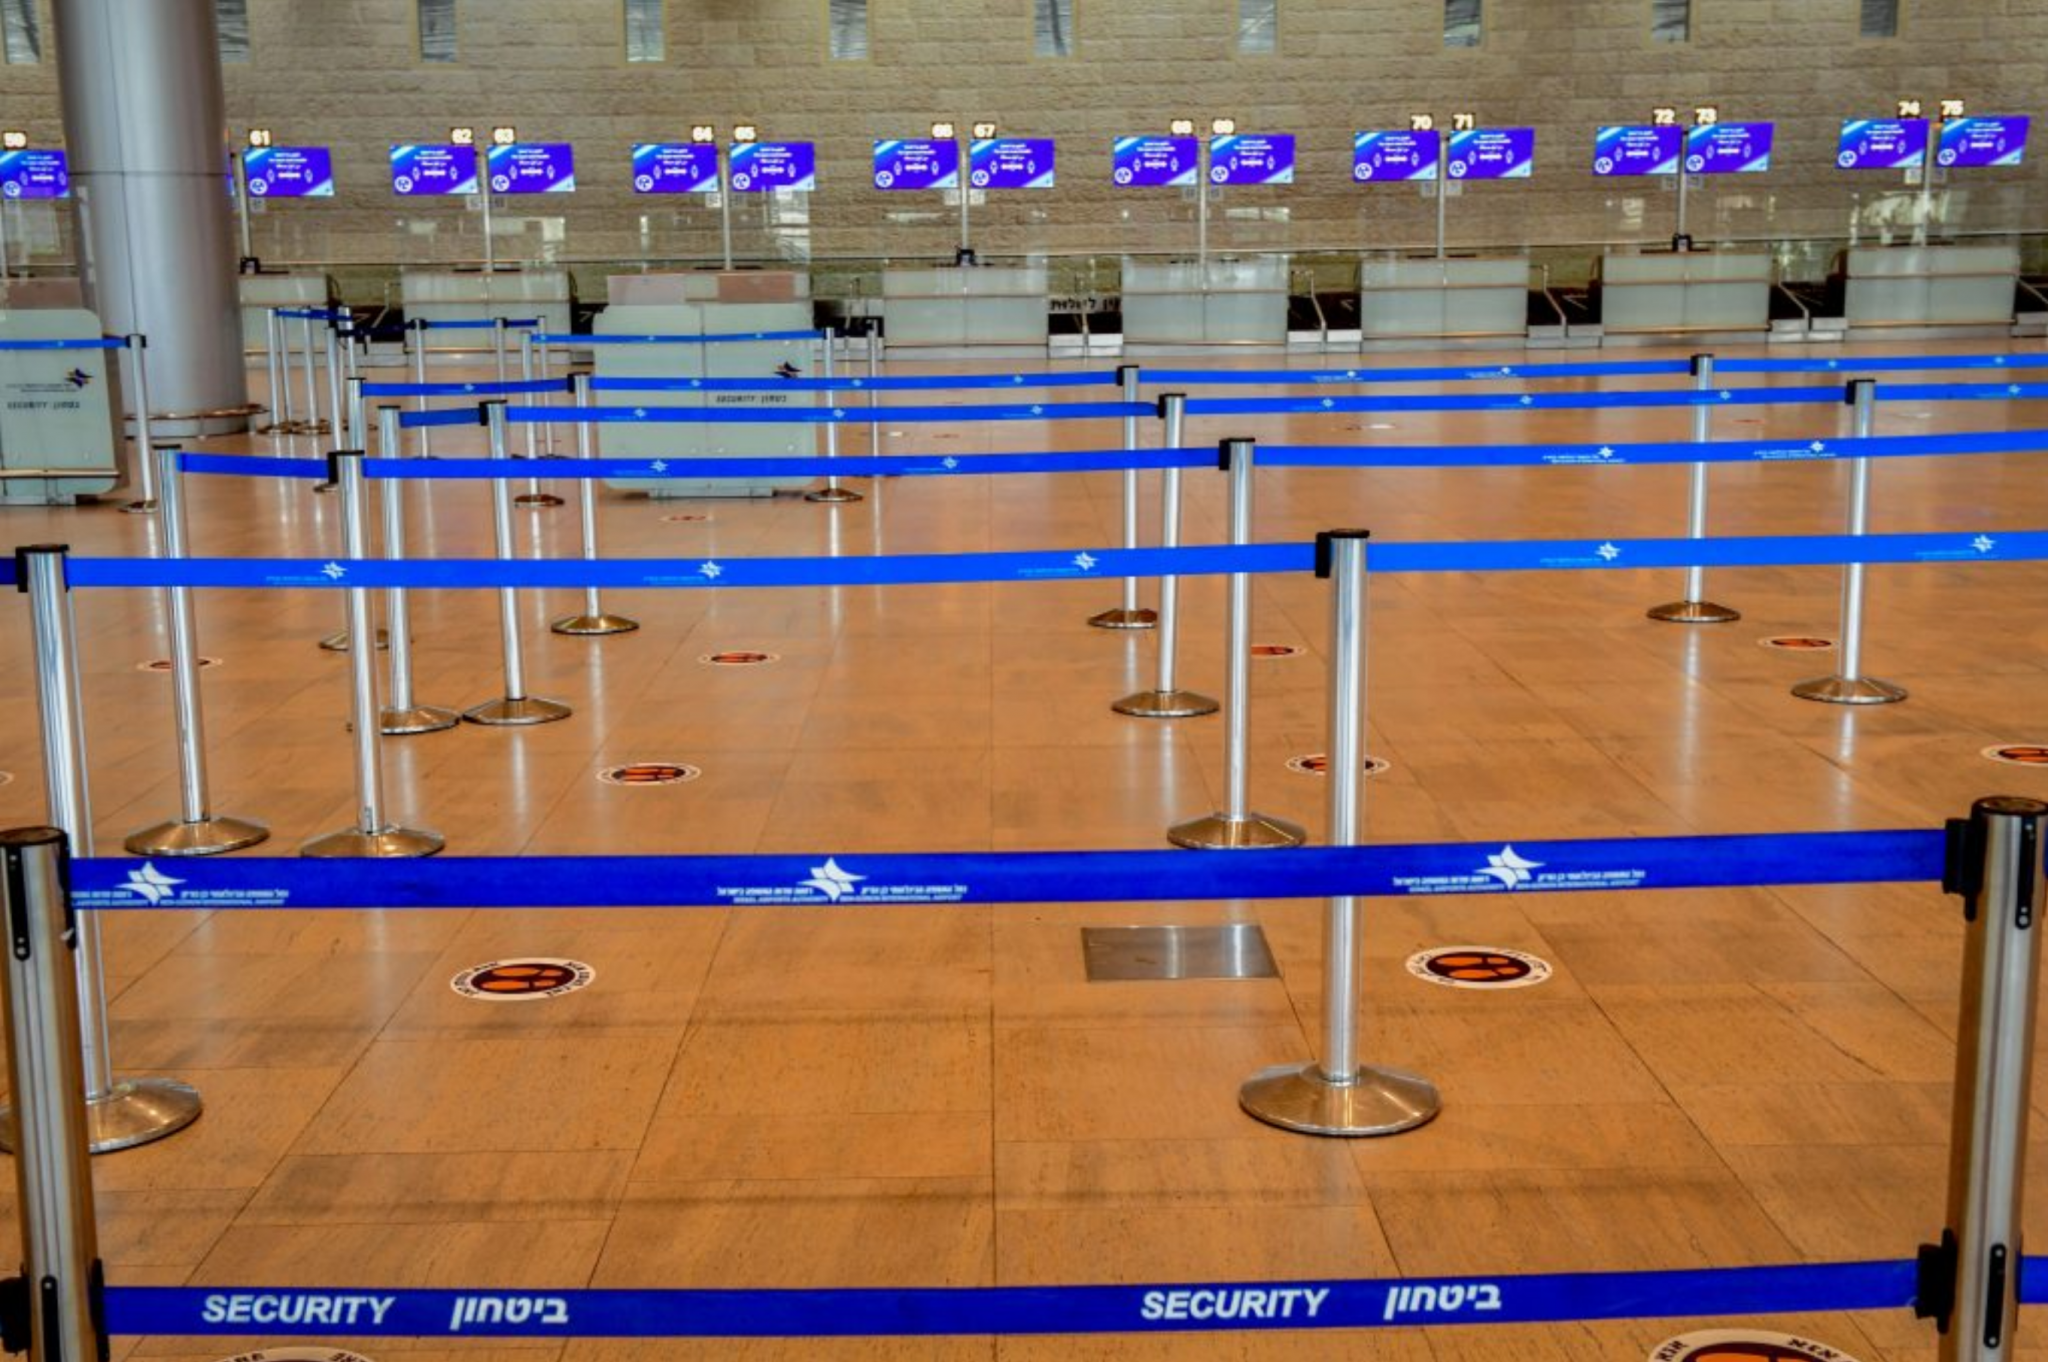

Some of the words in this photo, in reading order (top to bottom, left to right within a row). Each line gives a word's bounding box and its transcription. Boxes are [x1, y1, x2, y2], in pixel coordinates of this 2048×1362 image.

[1695, 107, 1717, 124] 73
[1898, 100, 1920, 116] 74
[1940, 99, 1964, 116] 75
[1411, 114, 1433, 130] 70
[1453, 114, 1474, 130] 71
[1653, 108, 1675, 124] 72
[249, 130, 271, 146] 61
[692, 126, 713, 142] 64
[973, 123, 996, 138] 67
[202, 1294, 395, 1324] SECURITY
[1140, 1288, 1330, 1320] SECURITY
[1383, 1283, 1502, 1320] ביטחון
[449, 1297, 570, 1331] ביטחון
